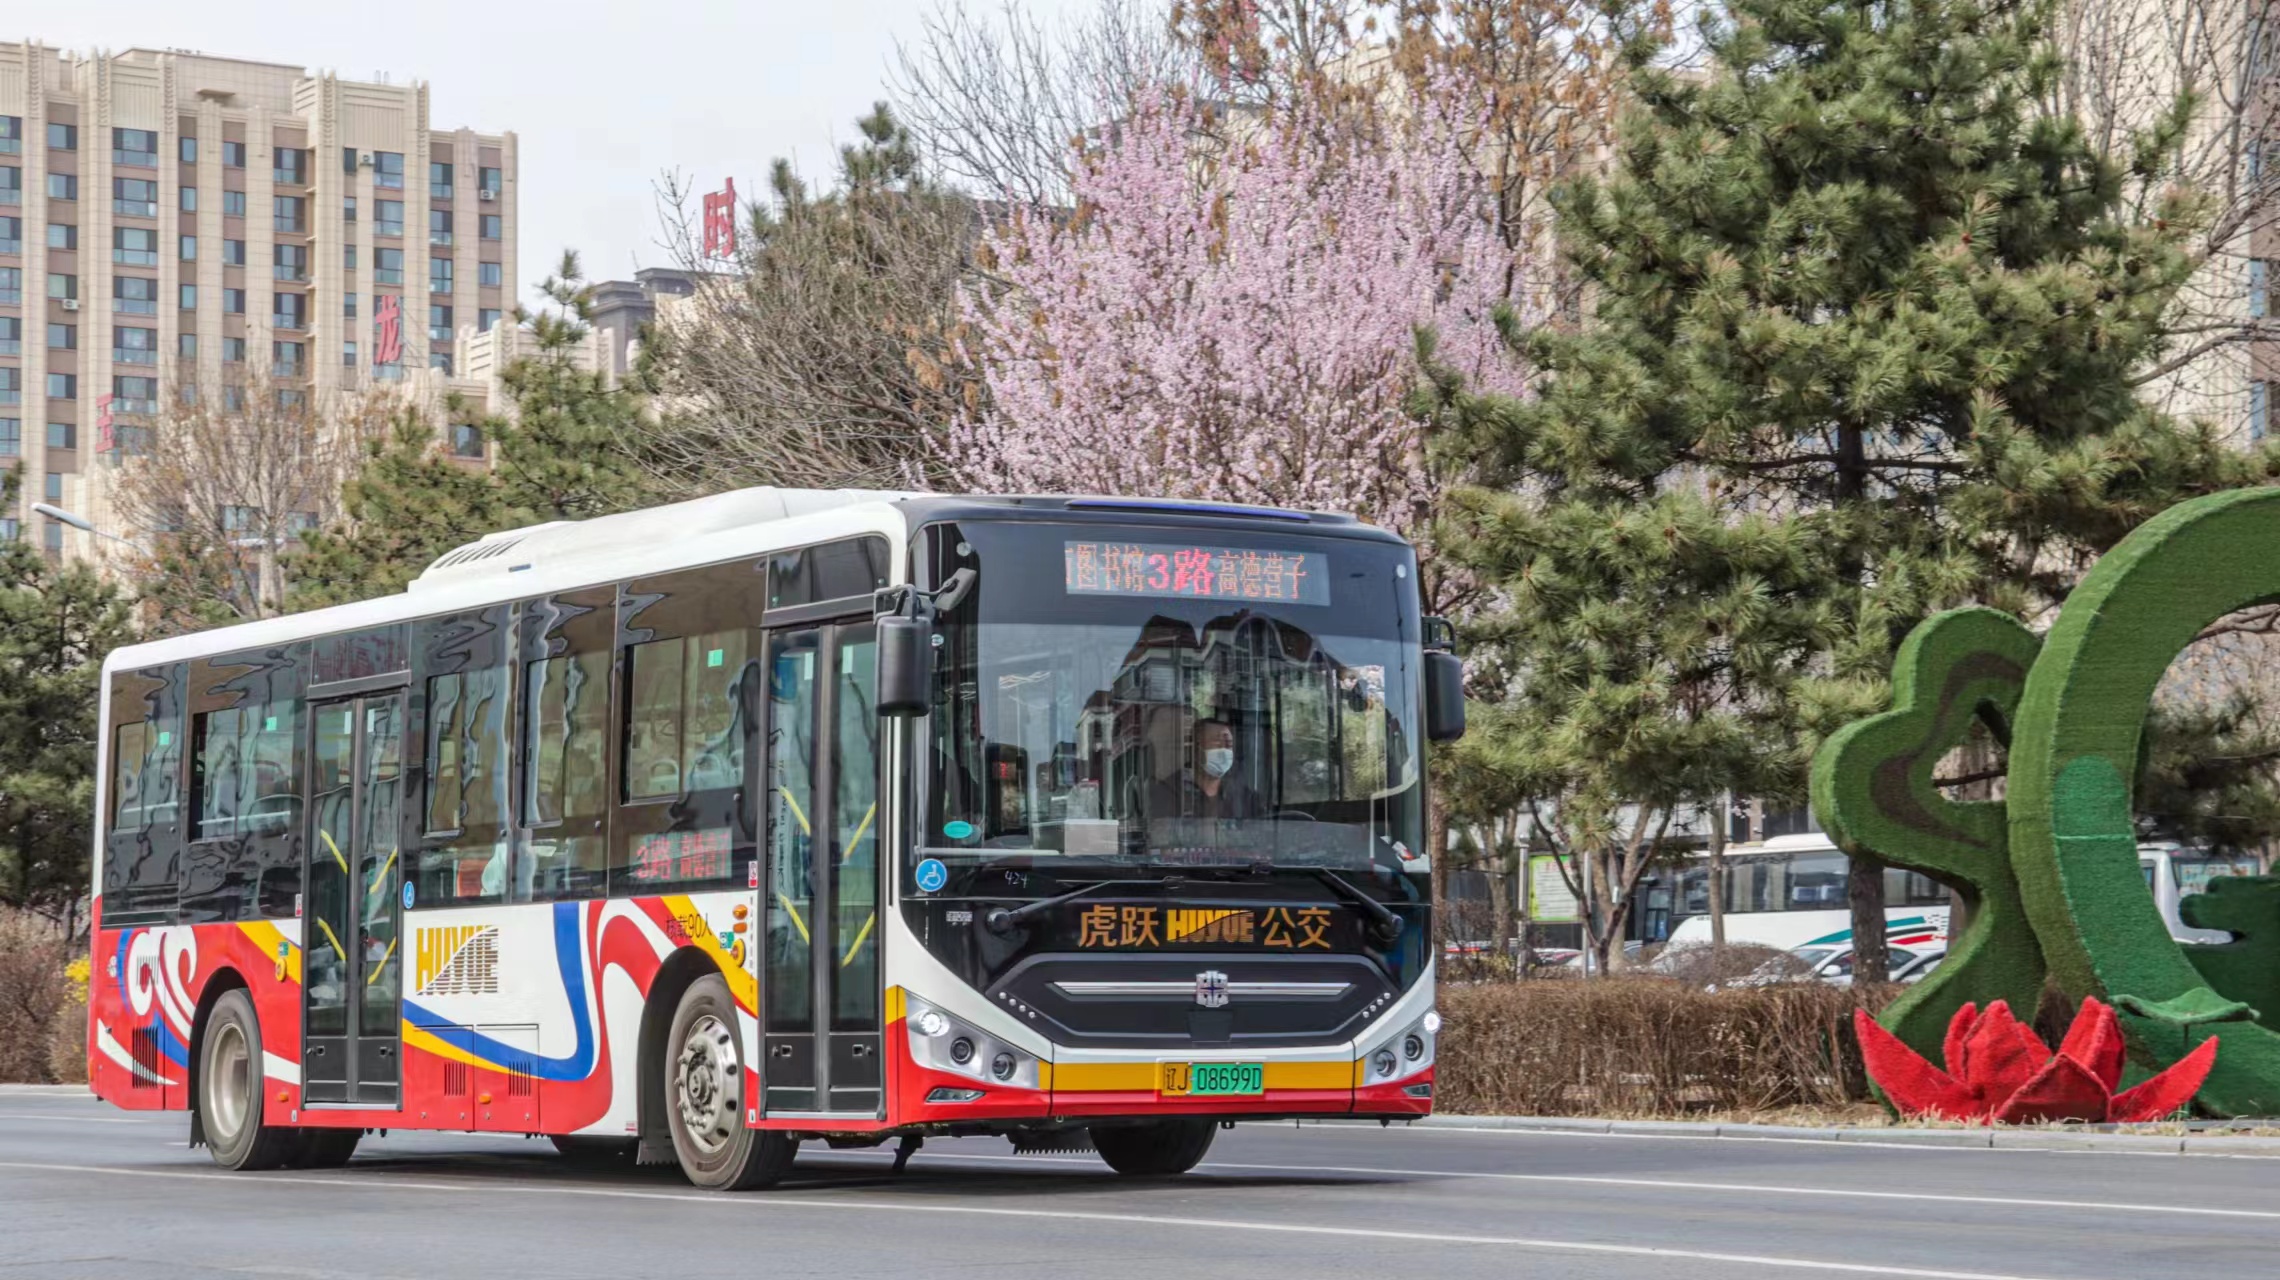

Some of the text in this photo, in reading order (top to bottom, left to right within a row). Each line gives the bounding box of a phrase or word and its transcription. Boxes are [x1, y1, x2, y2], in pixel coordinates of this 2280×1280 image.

[375, 294, 402, 365] 龙
[703, 177, 736, 258] 时
[1148, 549, 1214, 595] 3路
[1004, 870, 1027, 888] 424
[1079, 905, 1331, 948] 虎跃 HUYUE 公交
[416, 925, 499, 995] HUYUE
[1197, 1067, 1262, 1090] 08699D
